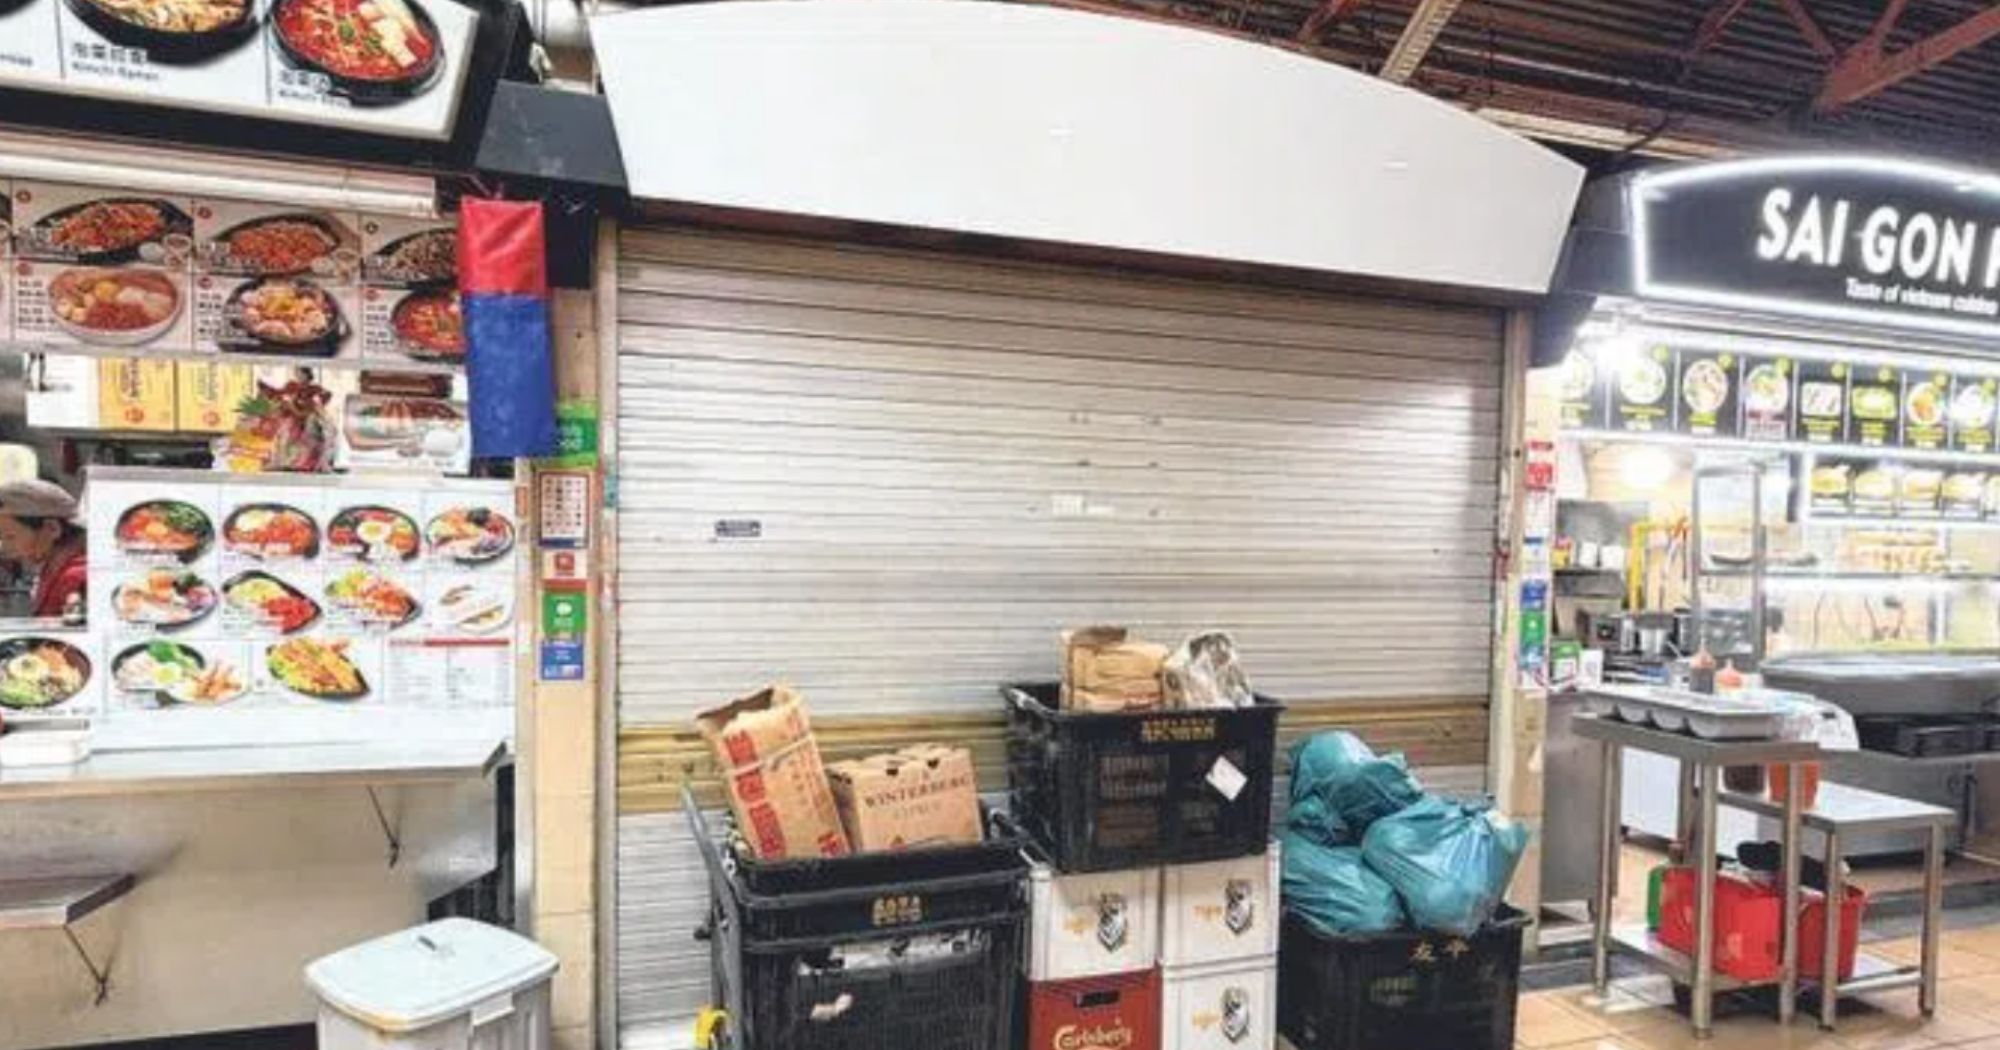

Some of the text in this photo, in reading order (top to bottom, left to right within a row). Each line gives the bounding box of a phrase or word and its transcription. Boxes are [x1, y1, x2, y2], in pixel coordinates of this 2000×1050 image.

[1755, 187, 1850, 267] SAI
[1860, 205, 1977, 287] GON
[1845, 276, 1882, 300] Taste
[1053, 1024, 1132, 1050] Carlsberg
